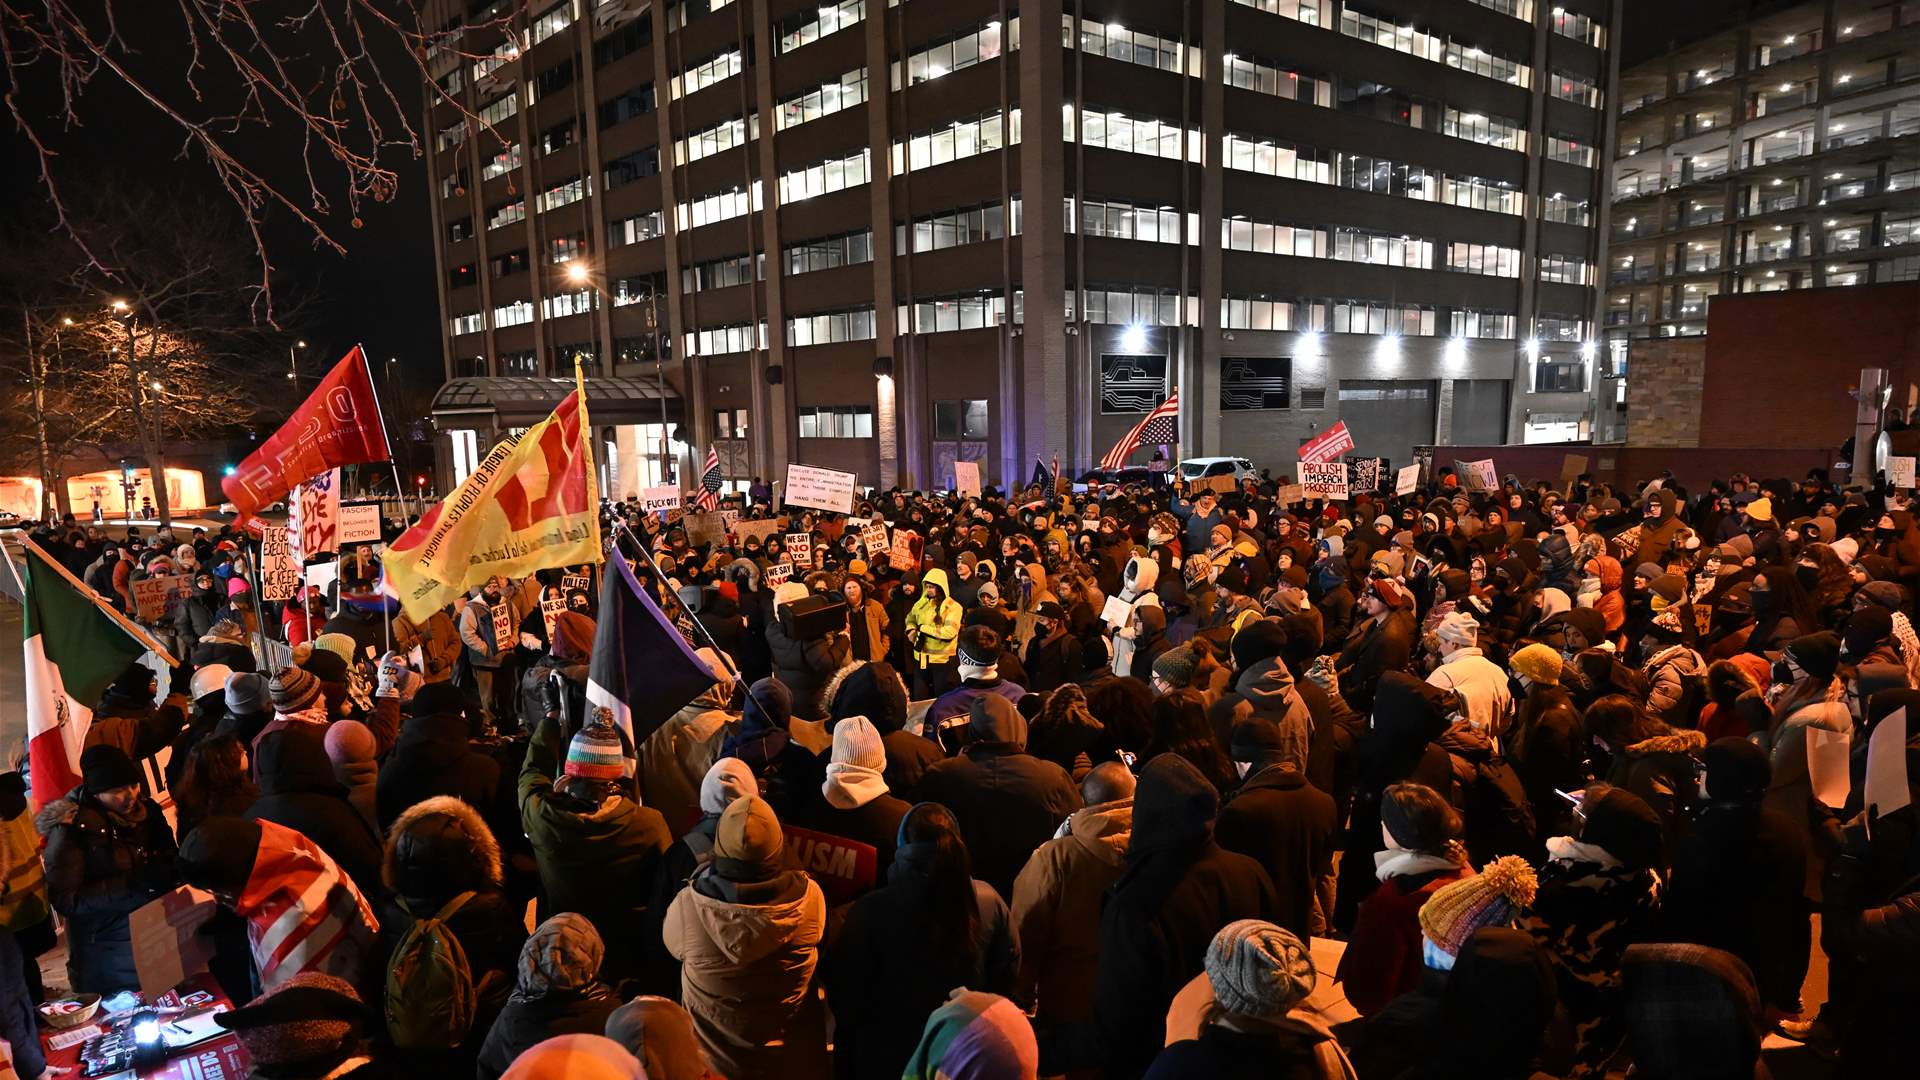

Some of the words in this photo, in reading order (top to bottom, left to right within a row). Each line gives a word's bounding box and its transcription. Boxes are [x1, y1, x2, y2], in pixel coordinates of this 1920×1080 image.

[481, 443, 511, 477] LEAGUE
[1303, 463, 1343, 475] ABOLISH
[472, 471, 489, 488] OF
[1304, 474, 1343, 484] IMPEACH
[1304, 483, 1347, 494] PROSECUTE
[647, 499, 666, 510] FUCK
[667, 497, 677, 506] OFF
[264, 528, 278, 542] THE
[278, 527, 289, 542] GO
[344, 529, 375, 538] FICTION
[863, 527, 872, 535] WE
[872, 525, 883, 533] SAY
[418, 521, 455, 567] STRUGGLE
[866, 533, 886, 543] NO
[264, 542, 291, 556] EXECUT
[788, 544, 809, 552] NO
[275, 556, 288, 571] US
[768, 568, 778, 576] WE
[779, 566, 791, 574] SAY
[263, 570, 275, 586] WE
[276, 569, 297, 585] KEEP
[563, 577, 588, 589] KILLER
[136, 581, 163, 595] ICE
[175, 577, 190, 589] IS
[264, 586, 278, 599] US
[492, 607, 500, 618] WE
[542, 603, 554, 612] WE
[495, 617, 509, 630] NO
[499, 629, 507, 637] TO
[201, 1051, 218, 1067] DC
